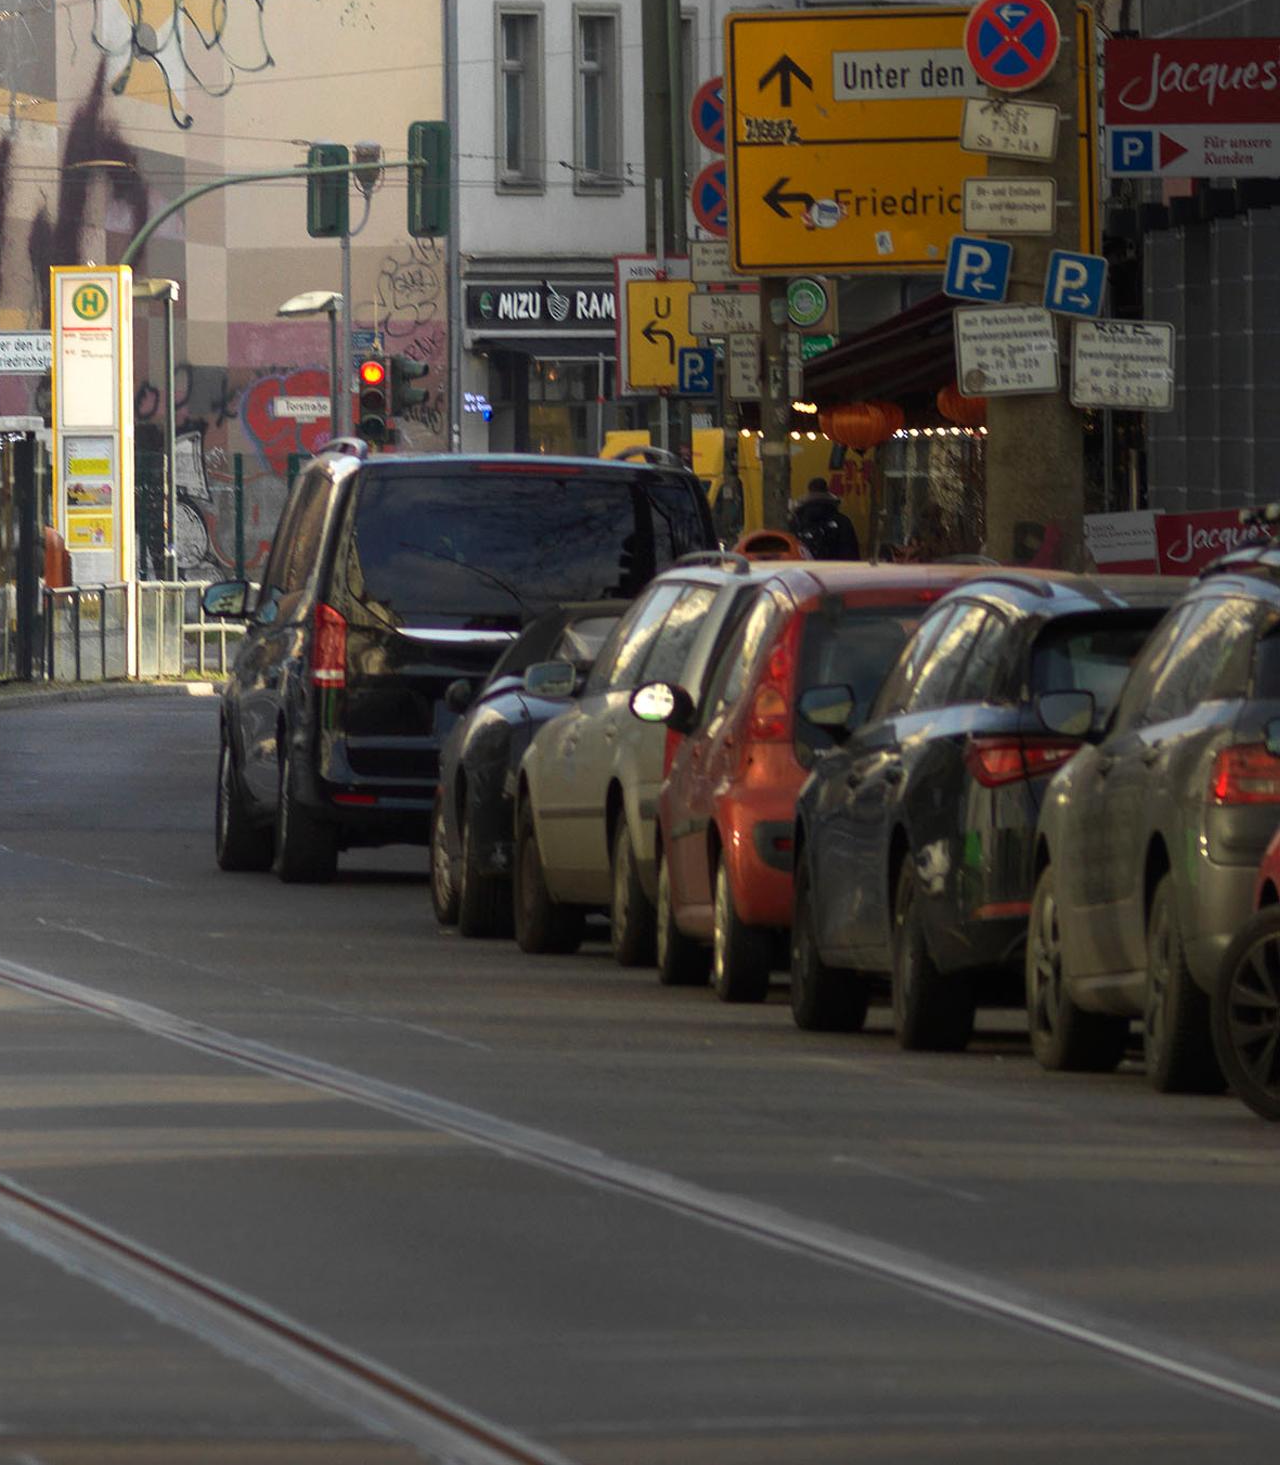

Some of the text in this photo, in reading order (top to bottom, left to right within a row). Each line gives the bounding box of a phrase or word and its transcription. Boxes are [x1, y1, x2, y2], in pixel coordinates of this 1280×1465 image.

[843, 61, 911, 90] Unter
[921, 58, 965, 87] den
[1230, 136, 1273, 149] unsere
[1204, 151, 1255, 166] Kunden
[497, 291, 542, 321] MIZU
[653, 296, 672, 319] U
[14, 337, 33, 352] den
